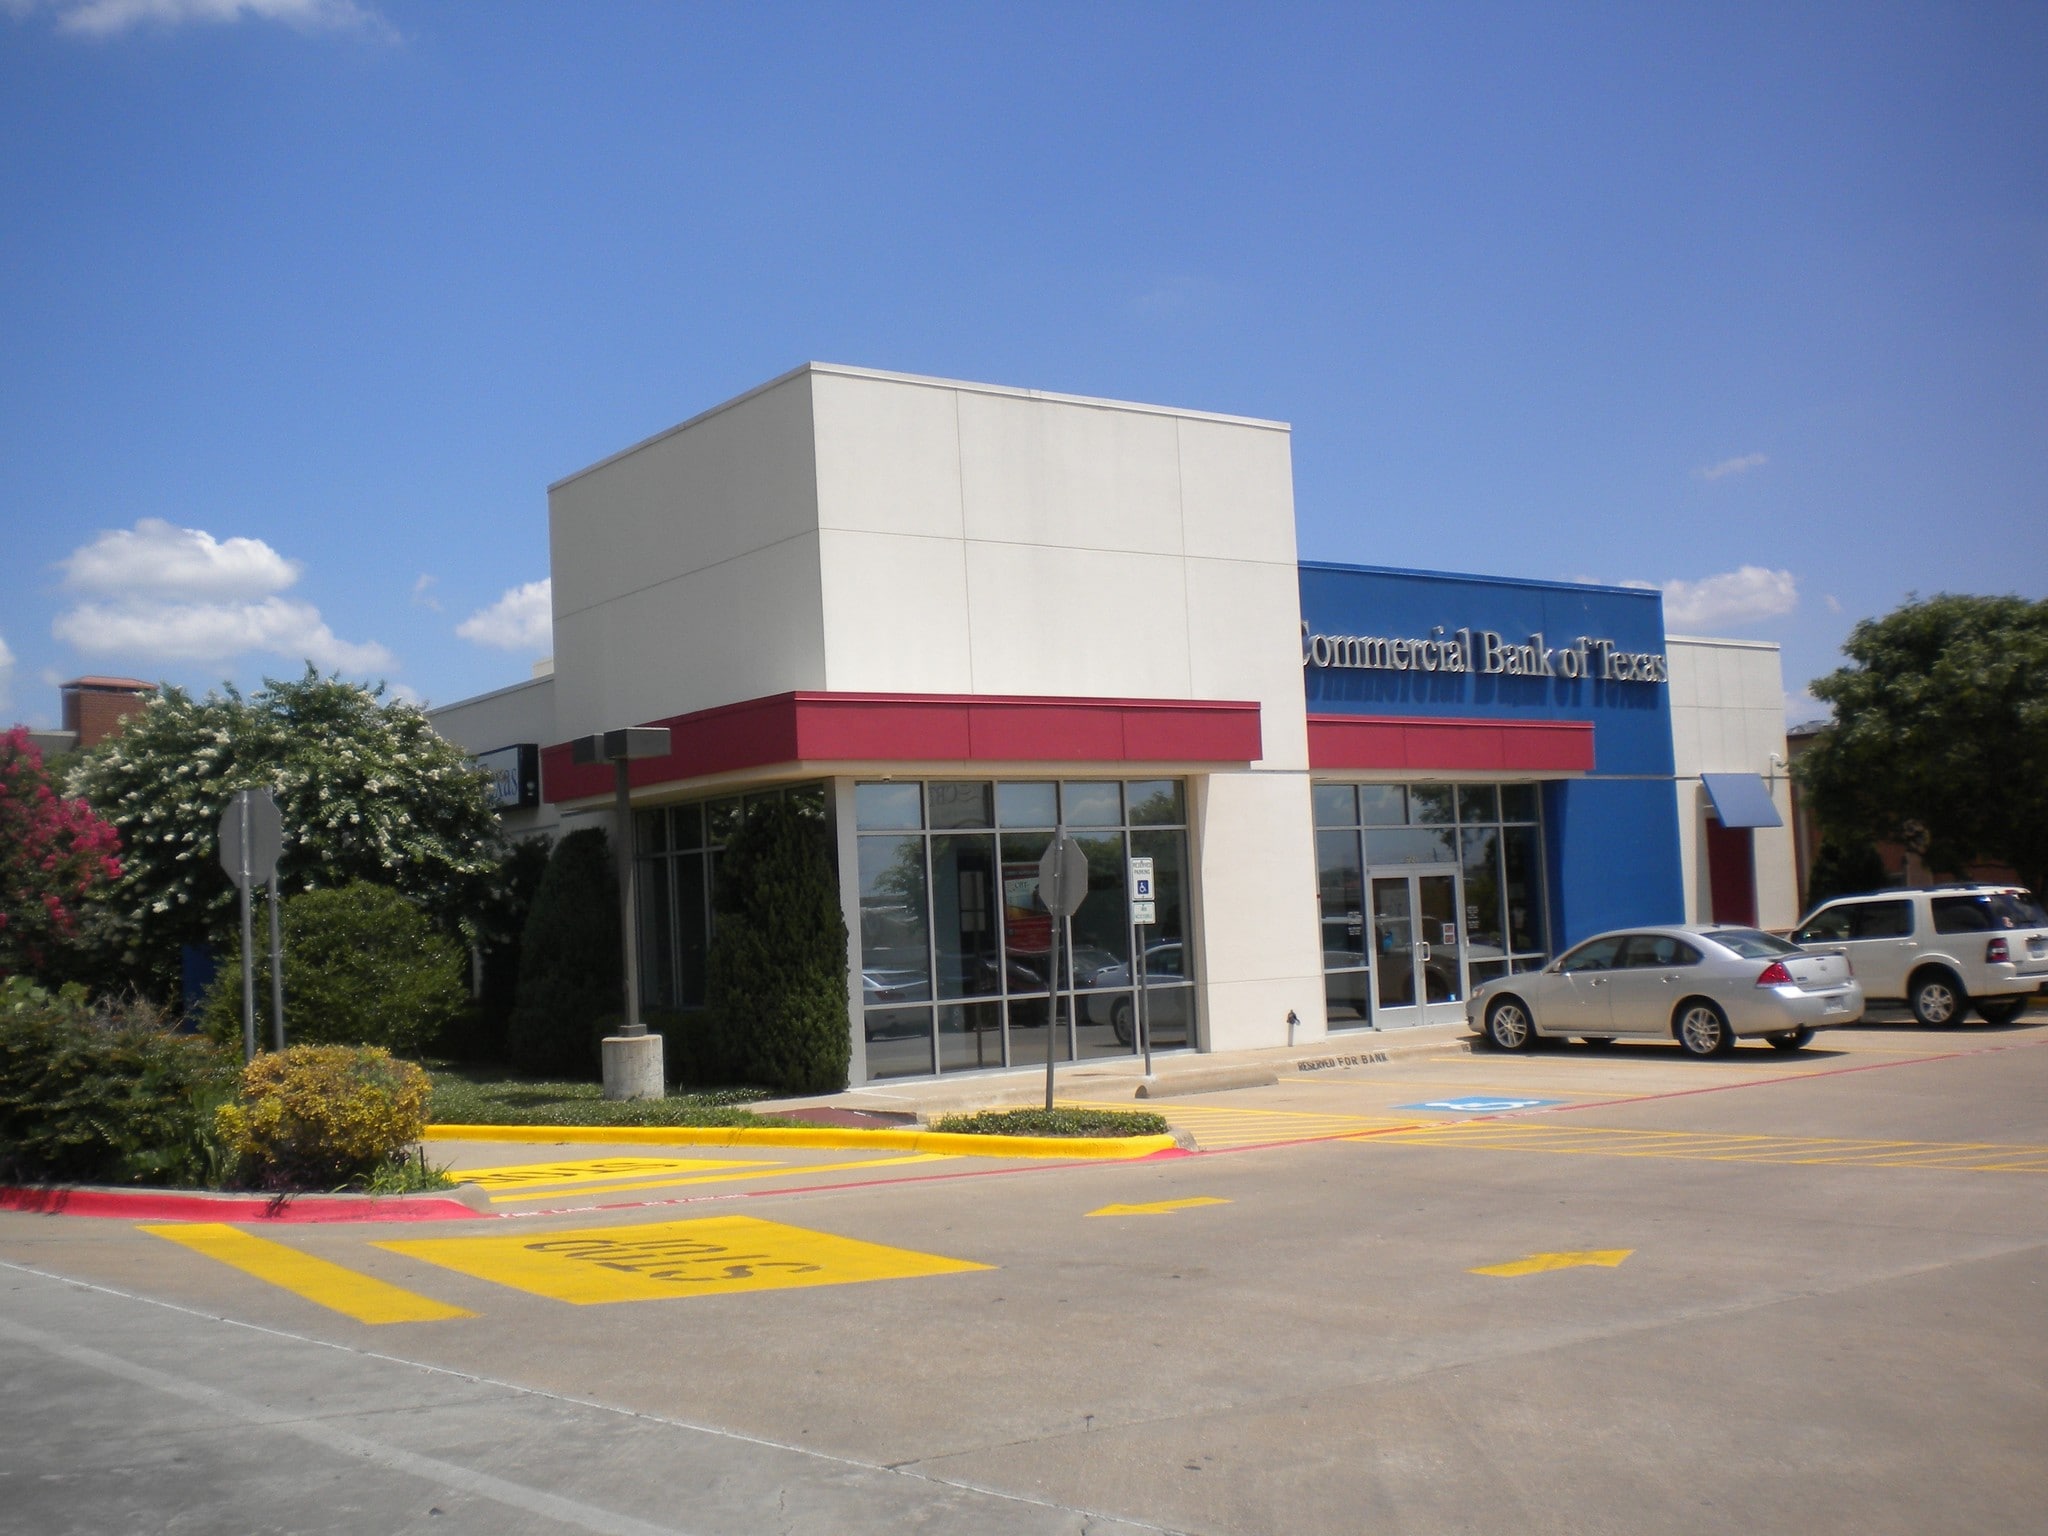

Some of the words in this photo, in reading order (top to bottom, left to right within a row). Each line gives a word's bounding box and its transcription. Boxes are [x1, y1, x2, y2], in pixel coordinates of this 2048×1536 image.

[1480, 630, 1557, 676] Bank
[1558, 636, 1591, 680] of
[1596, 640, 1668, 683] Texas
[1297, 1058, 1336, 1072] RESERVED
[1336, 1056, 1359, 1067] FOR
[1360, 1053, 1388, 1065] BANK
[523, 1239, 823, 1282] STOP
